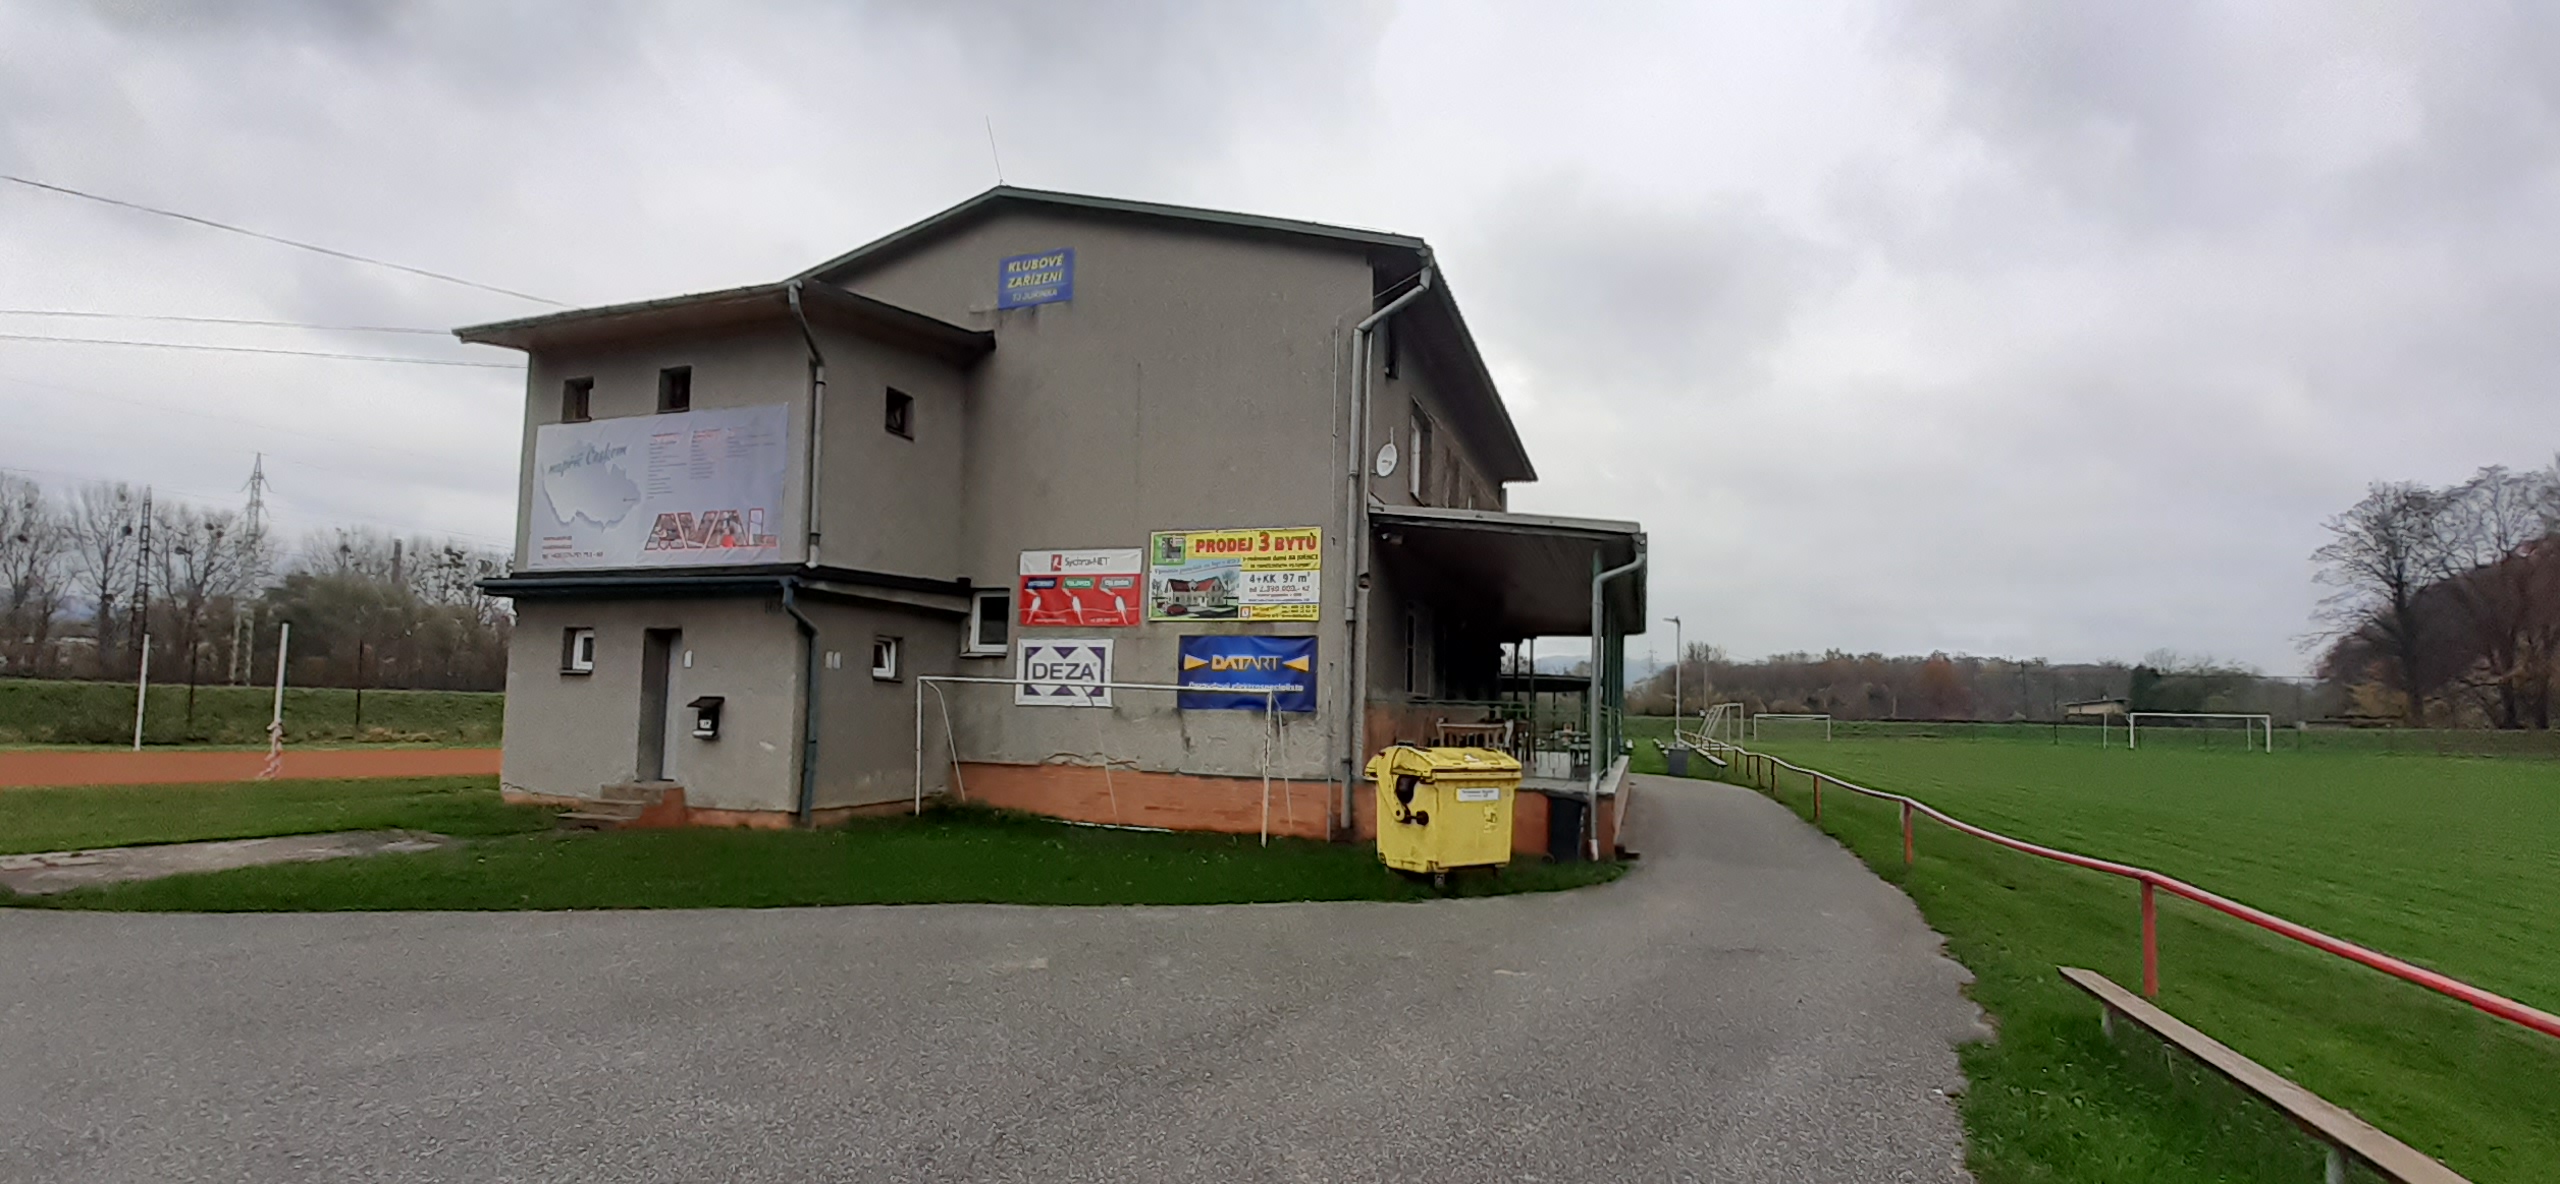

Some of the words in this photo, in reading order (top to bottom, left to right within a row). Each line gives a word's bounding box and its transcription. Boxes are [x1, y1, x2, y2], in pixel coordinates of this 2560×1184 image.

[1008, 253, 1064, 273] KLUBOVÉ
[644, 508, 777, 551] AVAL
[1195, 537, 1253, 553] PRODEJ
[1258, 532, 1270, 551] 3
[1274, 532, 1318, 551] BYTŮ
[1282, 573, 1295, 583] 97
[1032, 662, 1095, 680] DEZA
[1211, 655, 1283, 671] DATART
